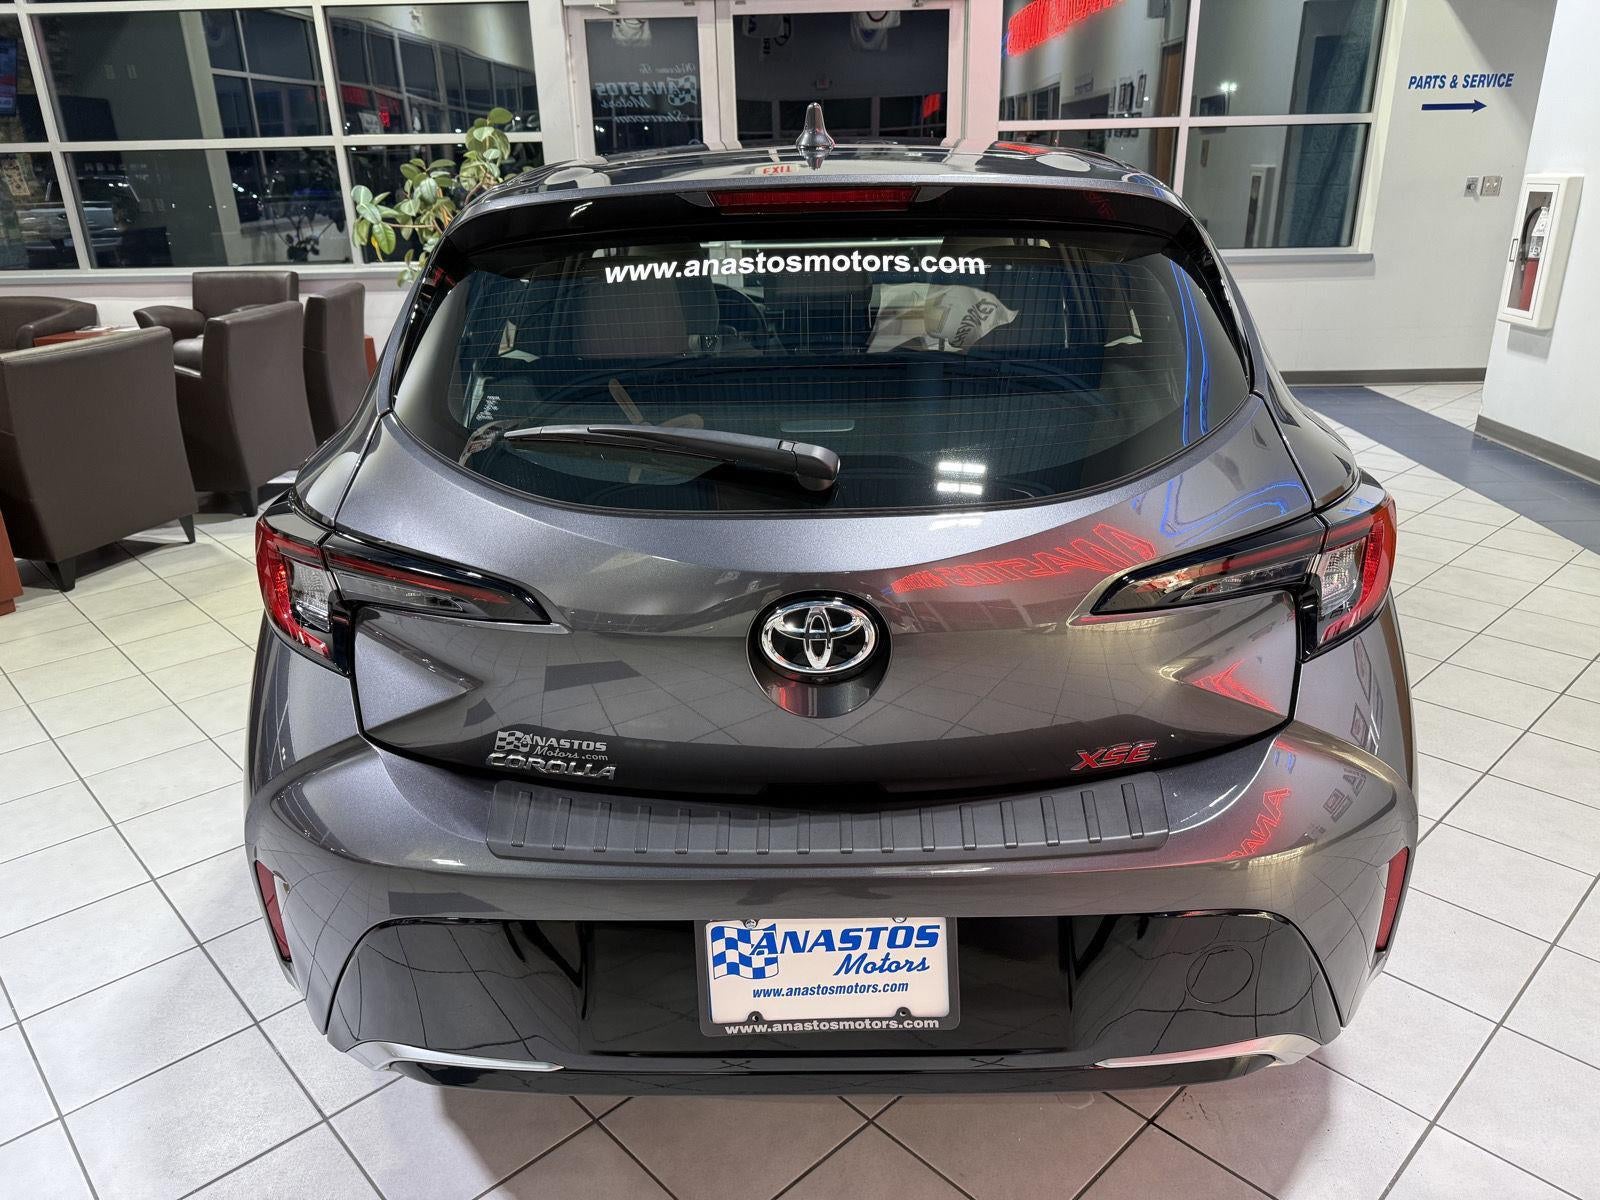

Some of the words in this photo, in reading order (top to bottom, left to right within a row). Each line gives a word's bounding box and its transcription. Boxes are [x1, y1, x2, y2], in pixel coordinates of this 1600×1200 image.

[1407, 74, 1447, 90] PARTS
[1449, 74, 1459, 89] &
[1461, 72, 1515, 89] SERVICE
[605, 249, 986, 284] www.anastosmotors.com
[520, 732, 608, 752] ANASTOS
[486, 752, 617, 780] COROLLA
[1070, 740, 1157, 772] XSE
[749, 924, 941, 956] ANASTOS
[832, 952, 930, 976] Motors
[752, 981, 909, 999] www.anastosmotors.com
[724, 1018, 940, 1035] www.anastosmotors.com
